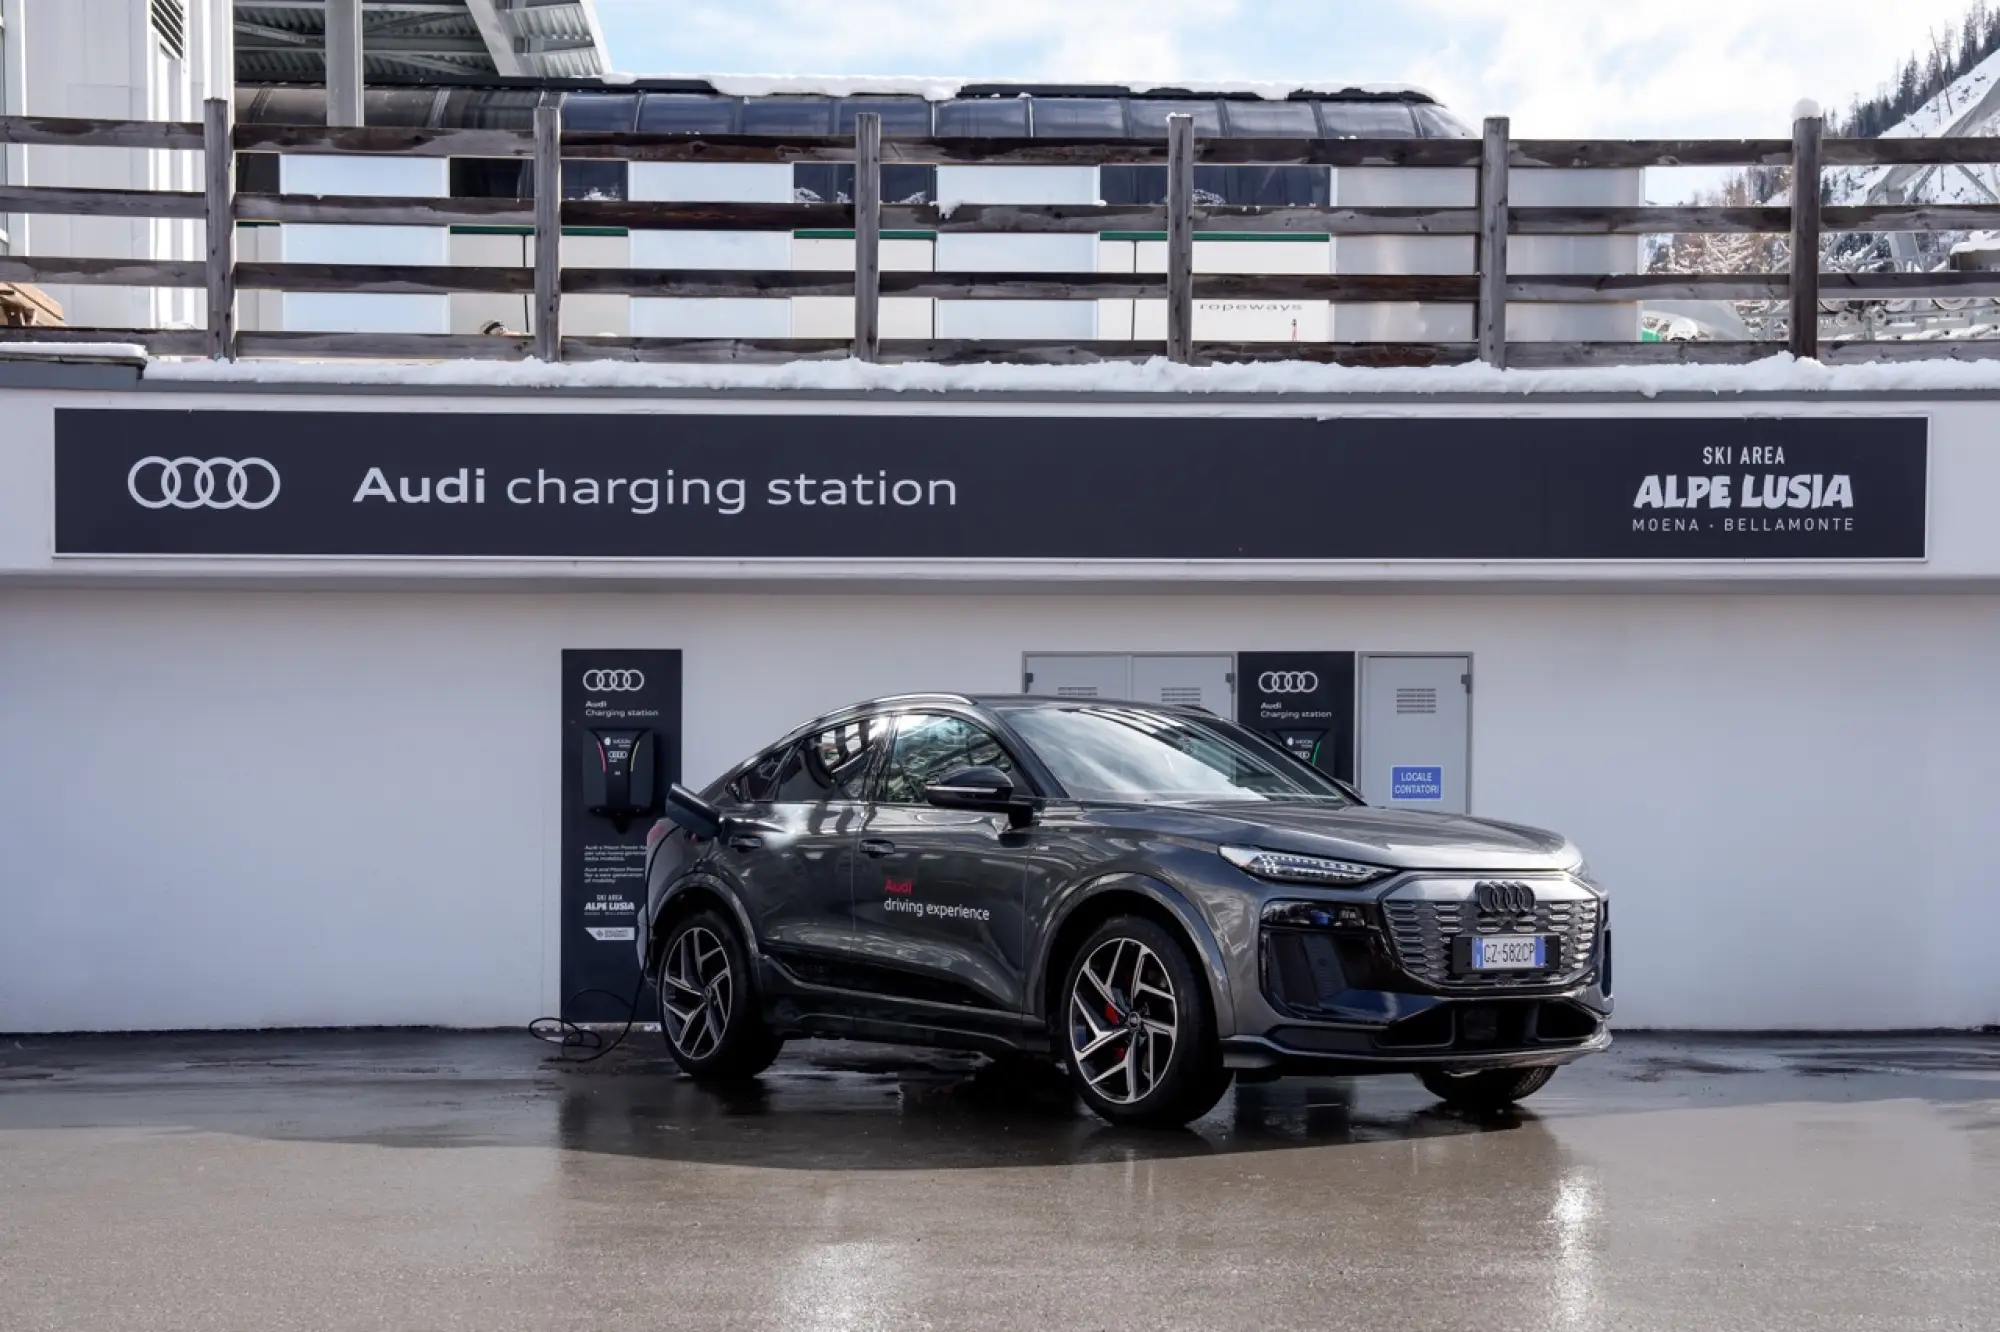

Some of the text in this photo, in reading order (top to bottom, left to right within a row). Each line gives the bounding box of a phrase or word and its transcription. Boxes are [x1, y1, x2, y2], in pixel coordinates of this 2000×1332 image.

[1702, 446, 1786, 465] SKI AREA
[353, 466, 957, 515] Audi charging station
[1632, 473, 1854, 510] ALPE LUSIA
[1632, 517, 1854, 532] MOENA BELLAMONTE
[585, 700, 607, 708] Audi
[1260, 701, 1282, 710] Audi
[585, 708, 659, 718] Charging station
[1260, 710, 1332, 719] Charging station
[1400, 772, 1433, 782] LOCALE
[1394, 784, 1440, 794] CONTATORI
[885, 879, 913, 894] Audi
[584, 902, 607, 911] ALPE
[884, 898, 990, 921] driving experience
